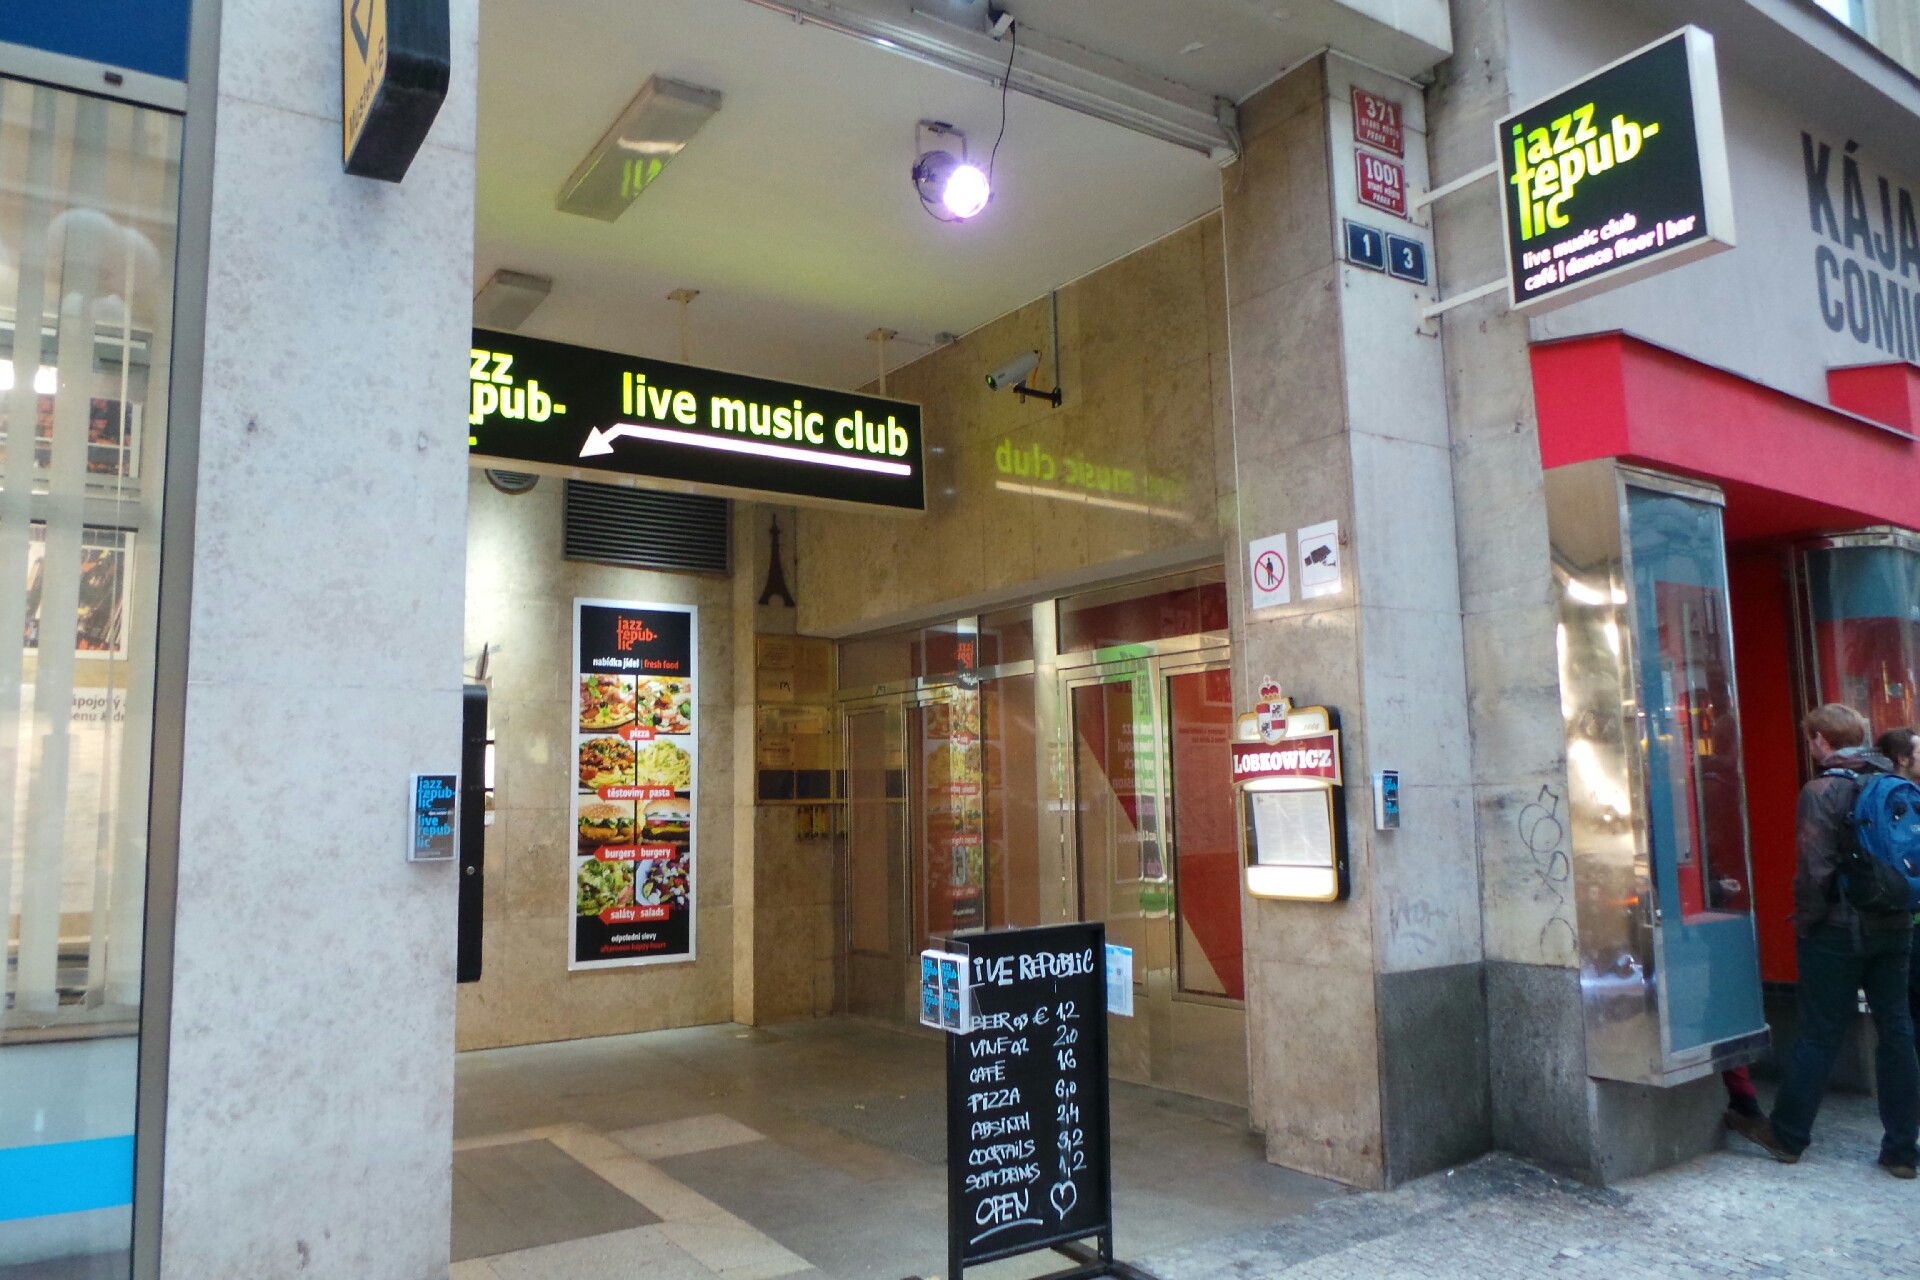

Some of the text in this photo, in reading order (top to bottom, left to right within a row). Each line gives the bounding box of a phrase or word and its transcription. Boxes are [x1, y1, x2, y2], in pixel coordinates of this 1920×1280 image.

[1365, 97, 1395, 125] 371
[1512, 102, 1598, 164] jazz
[1365, 158, 1399, 188] 1001
[1519, 190, 1570, 241] lic
[1362, 233, 1372, 257] 1
[1522, 212, 1637, 270] live music club
[1402, 247, 1415, 270] 3
[1524, 264, 1557, 291] café
[1565, 247, 1614, 277] dance
[1613, 229, 1656, 259] floor
[1664, 215, 1697, 240] bar
[469, 379, 567, 425] pub-
[621, 372, 910, 458] live music club
[618, 615, 643, 631] jazz
[617, 641, 633, 650] lic
[593, 656, 623, 668] nabídka
[644, 659, 662, 669] fresh
[663, 660, 679, 670] food
[629, 727, 651, 740] pizza
[1233, 748, 1332, 774] LOBKOWICZ
[418, 777, 443, 790] jazz
[607, 787, 671, 799] těstoviny pasta
[418, 813, 439, 827] live
[604, 845, 671, 859] burgers burgery
[610, 907, 665, 921] saláty salads
[971, 1011, 1015, 1033] BEER
[975, 1187, 1030, 1226] OPEN
